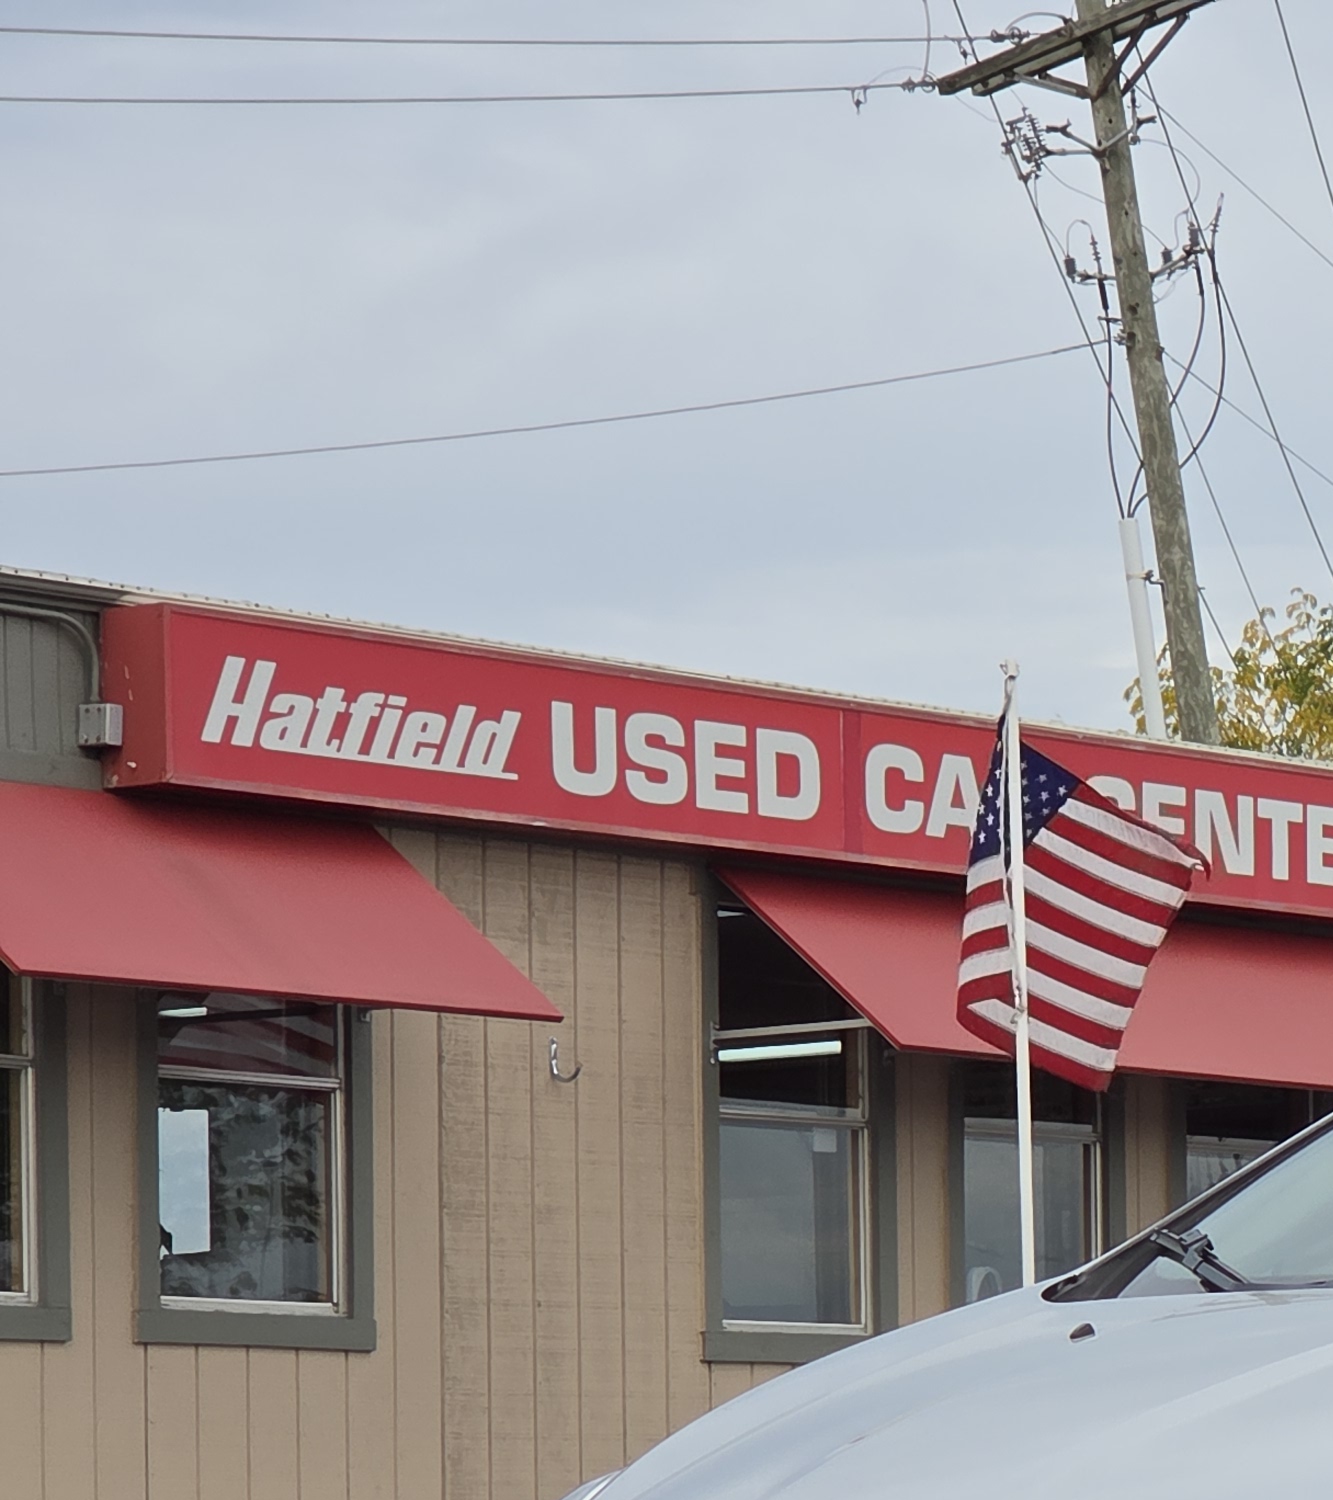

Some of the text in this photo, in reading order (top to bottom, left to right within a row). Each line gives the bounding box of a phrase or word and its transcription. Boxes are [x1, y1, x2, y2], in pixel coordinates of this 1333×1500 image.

[201, 655, 522, 780] Hatfield
[551, 701, 821, 821] USED
[865, 743, 981, 850] CA
